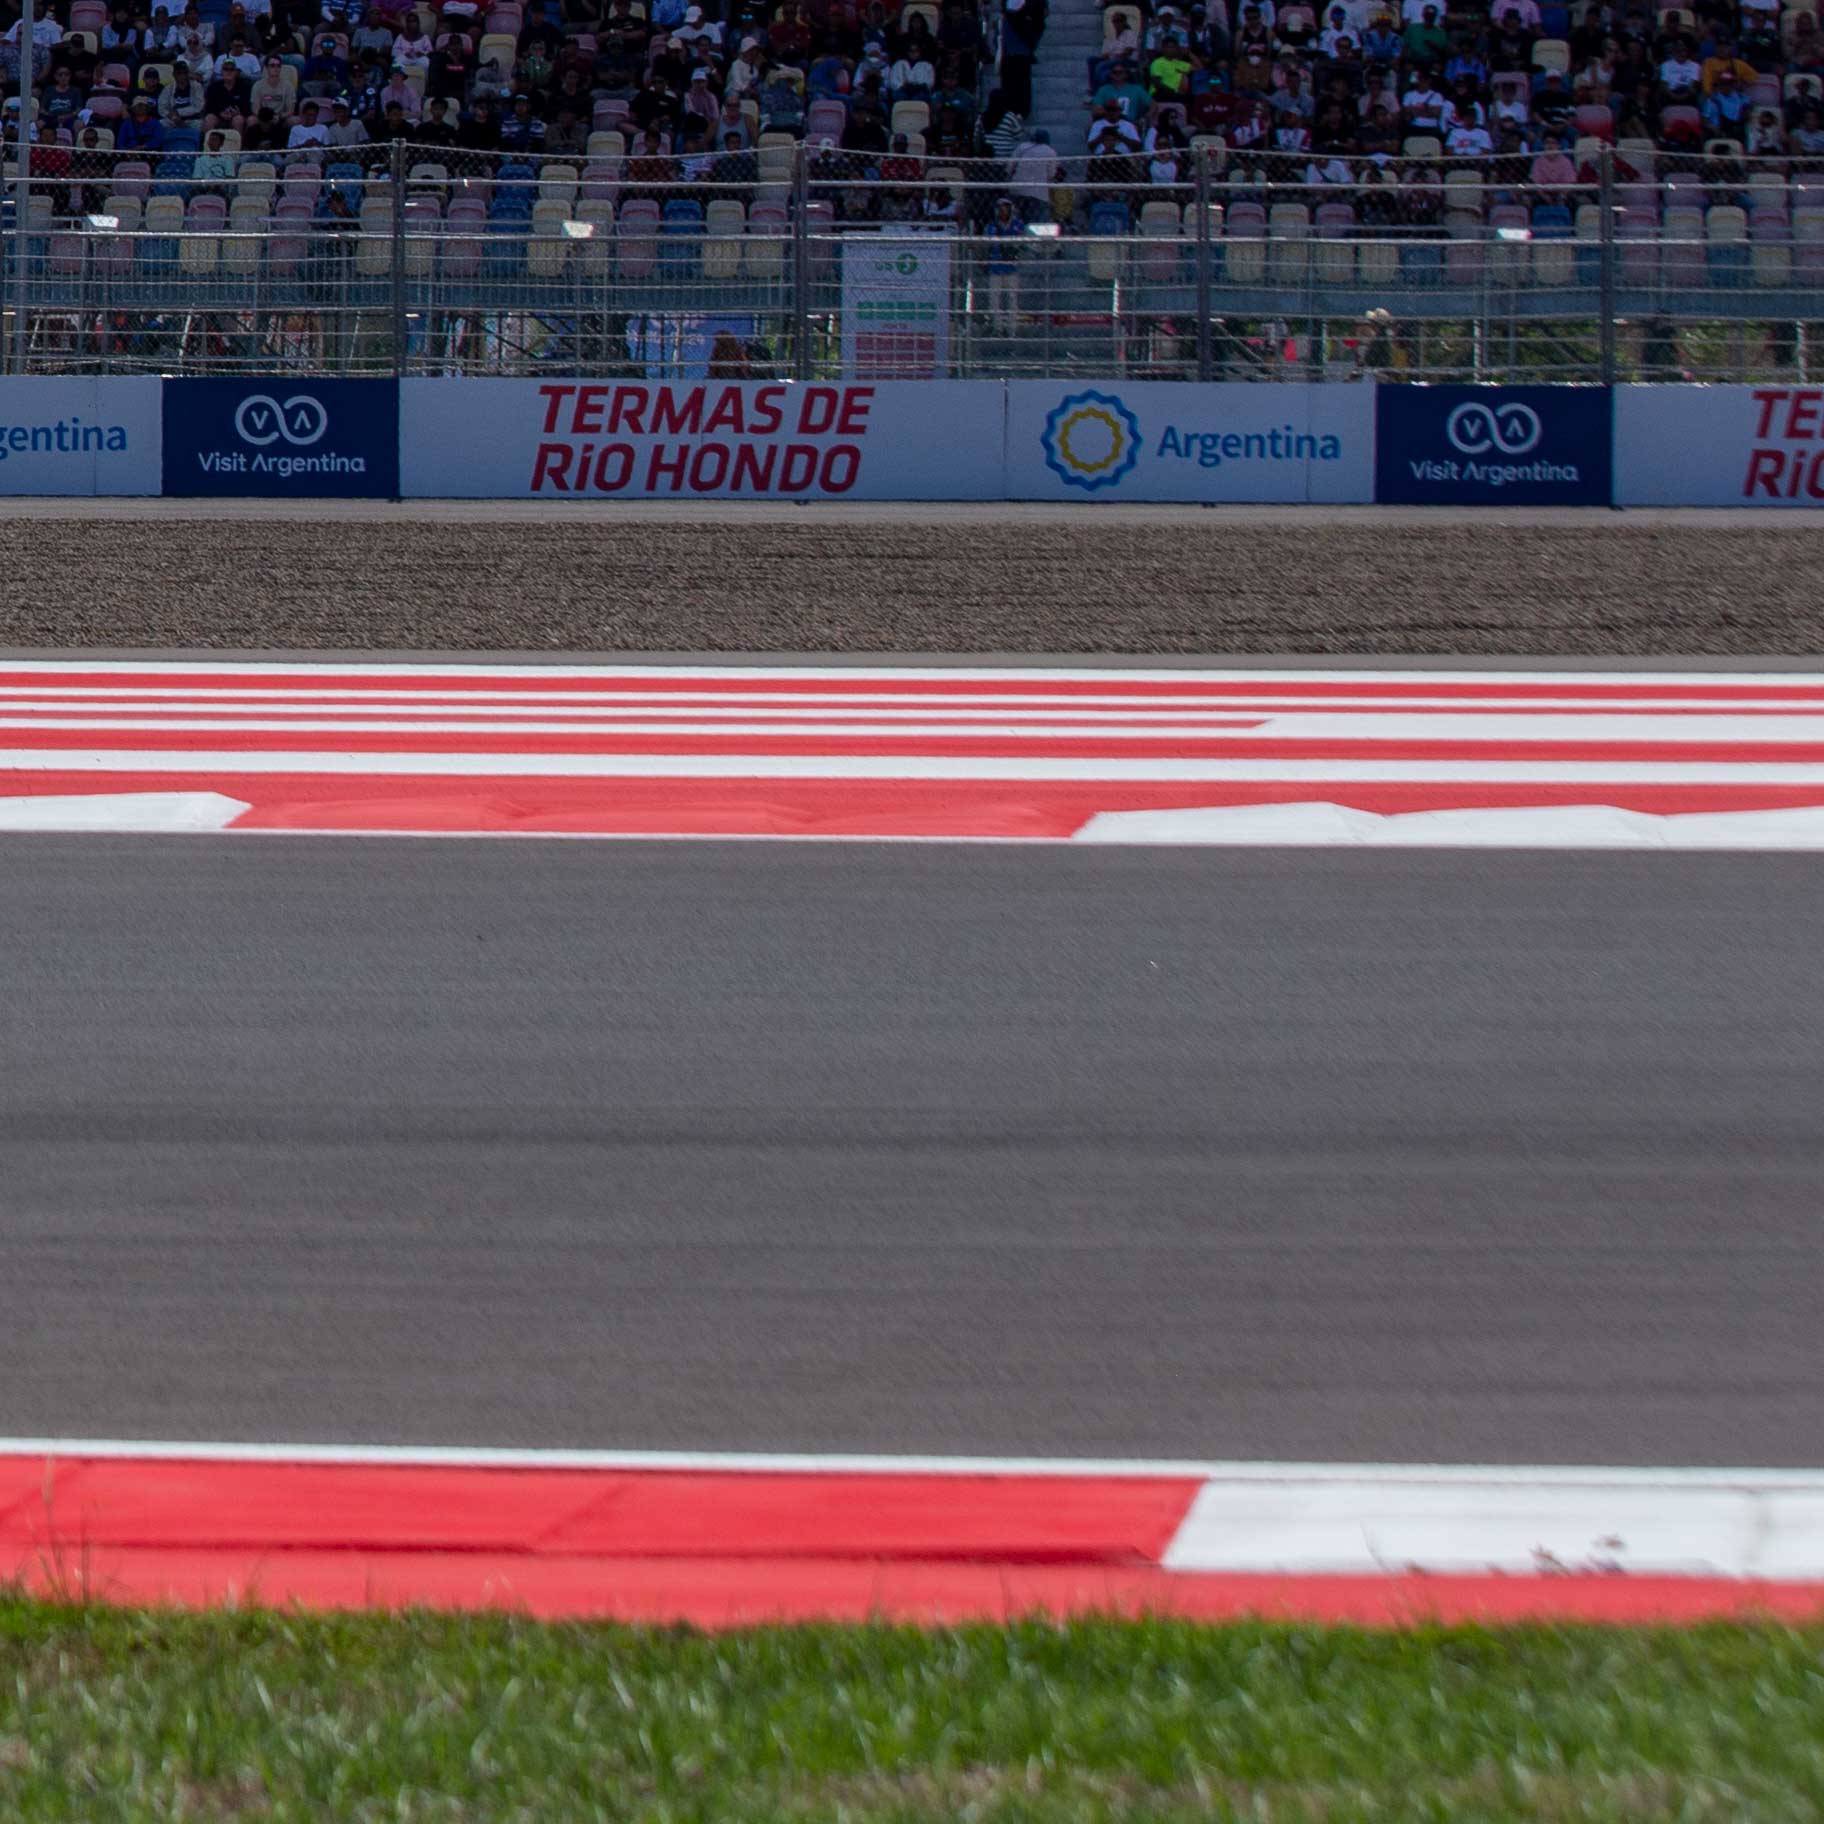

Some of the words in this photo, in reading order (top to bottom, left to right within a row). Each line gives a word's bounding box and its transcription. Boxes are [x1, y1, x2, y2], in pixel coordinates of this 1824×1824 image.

[539, 385, 786, 435] TERMAS
[797, 387, 875, 435] DE
[1752, 390, 1824, 439] TE
[198, 452, 247, 473] Visit
[251, 453, 365, 476] Argentina
[645, 443, 861, 493] HONDO
[1157, 425, 1340, 468] Argentina
[1408, 460, 1458, 481] Visit
[1463, 461, 1578, 486] Argentina
